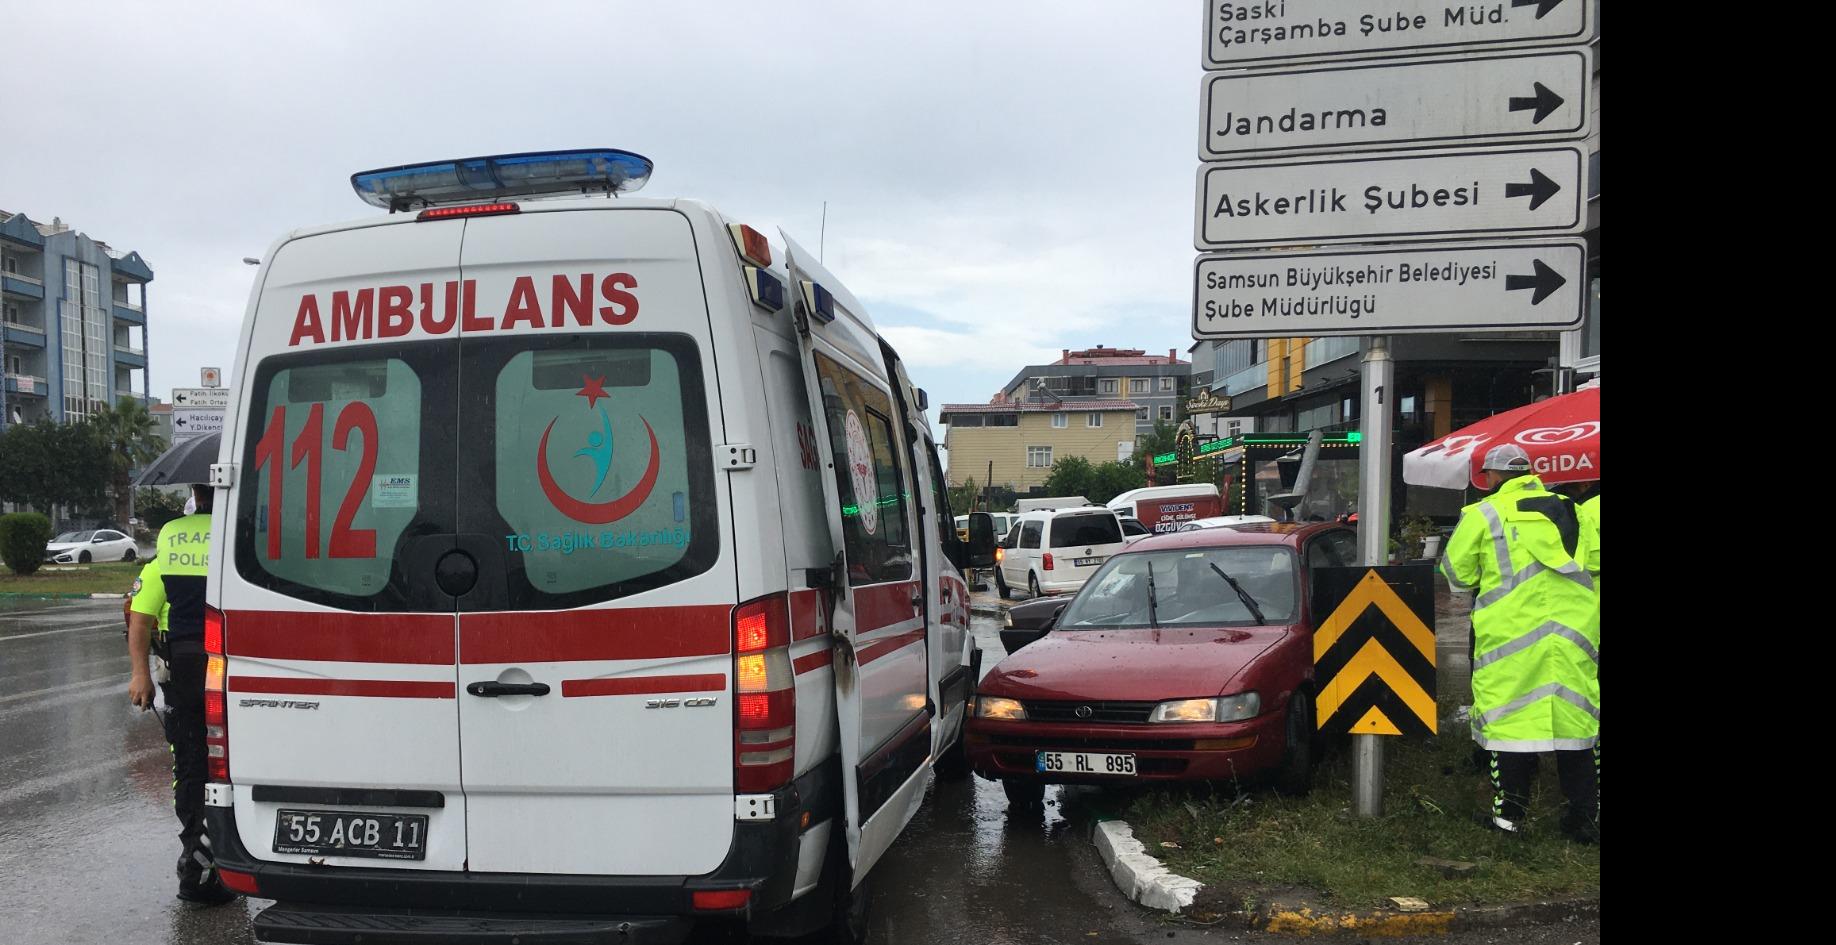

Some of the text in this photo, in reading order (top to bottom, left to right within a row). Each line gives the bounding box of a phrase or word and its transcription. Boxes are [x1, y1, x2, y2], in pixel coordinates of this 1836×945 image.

[1219, 0, 1286, 22] Saski
[1218, 4, 1510, 48] Çarşamba Şube Müd.
[1216, 108, 1387, 137] Jandarma
[1214, 181, 1480, 219] Askerlik Şubesi
[1206, 261, 1498, 291] Samsun Büyükşehir Belediyesi
[288, 272, 640, 347] AMBULANS
[1204, 300, 1255, 321] Şube
[1530, 453, 1593, 474] GiDA
[255, 400, 378, 561] 112
[537, 531, 595, 555] Sağlık
[239, 699, 320, 710] SPRINTER
[645, 697, 717, 709] 316 CDI
[1046, 754, 1134, 773] 55 RL 895
[290, 816, 419, 848] 55 ACB 11
